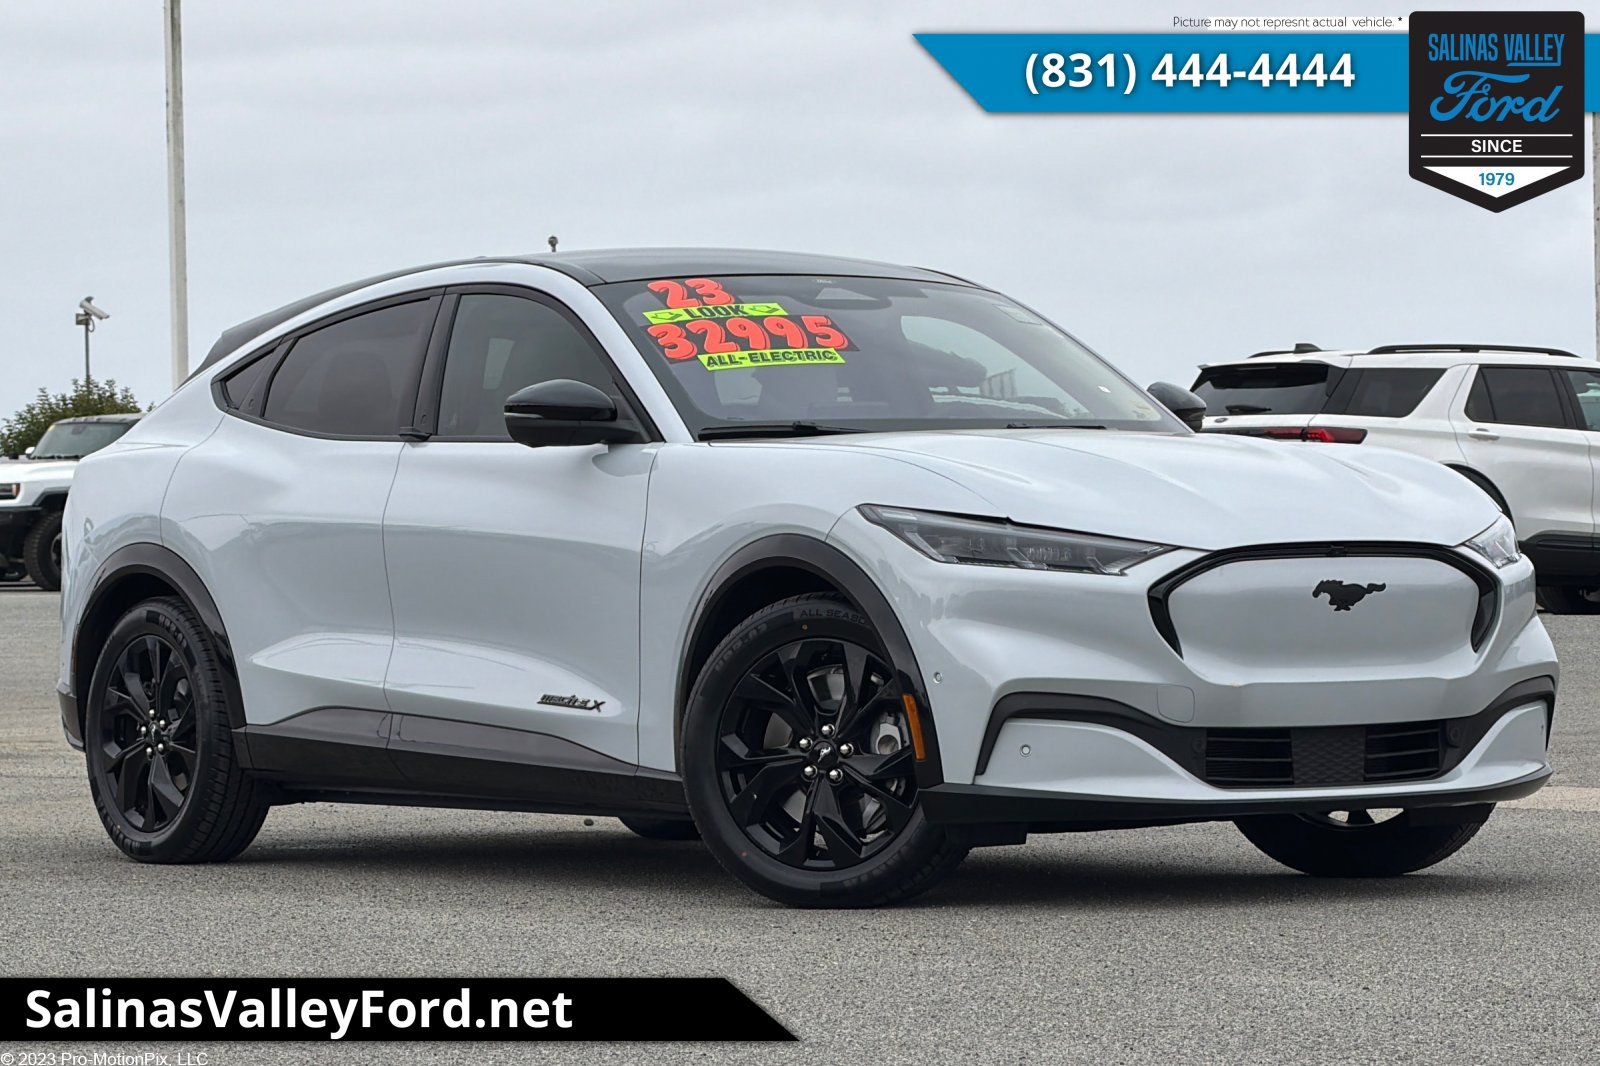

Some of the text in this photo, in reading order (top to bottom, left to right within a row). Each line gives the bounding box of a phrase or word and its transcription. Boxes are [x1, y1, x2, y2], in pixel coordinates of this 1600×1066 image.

[647, 278, 736, 309] 23
[683, 304, 750, 319] LOOK
[647, 315, 849, 360] 32995
[706, 349, 838, 368] ALL-ELECTRIC
